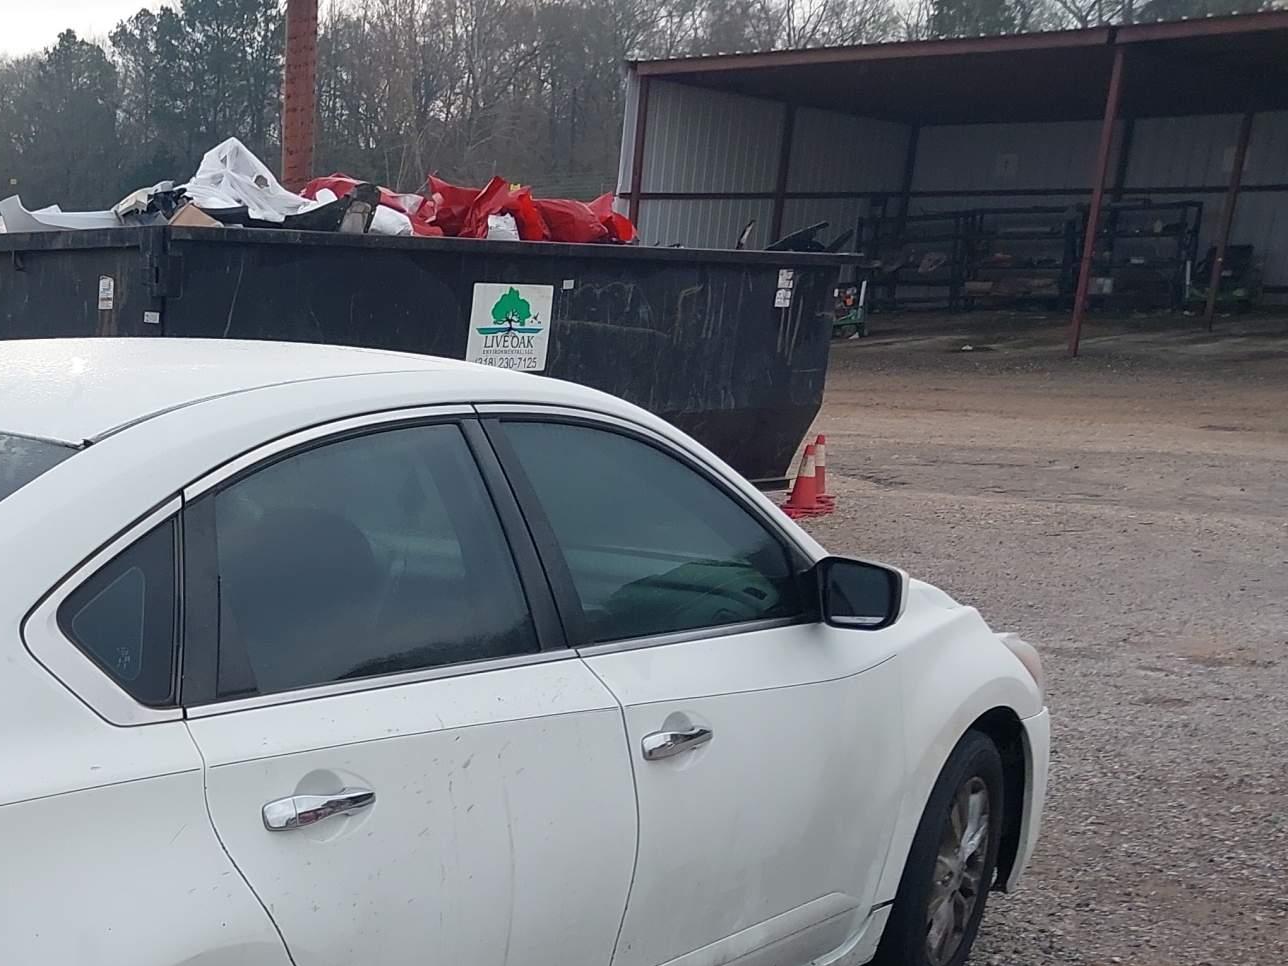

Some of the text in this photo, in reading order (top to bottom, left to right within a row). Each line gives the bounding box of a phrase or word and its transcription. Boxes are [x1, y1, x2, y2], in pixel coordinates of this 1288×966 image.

[484, 335, 535, 349] LIVE OAK
[498, 357, 537, 369] 230-7125
